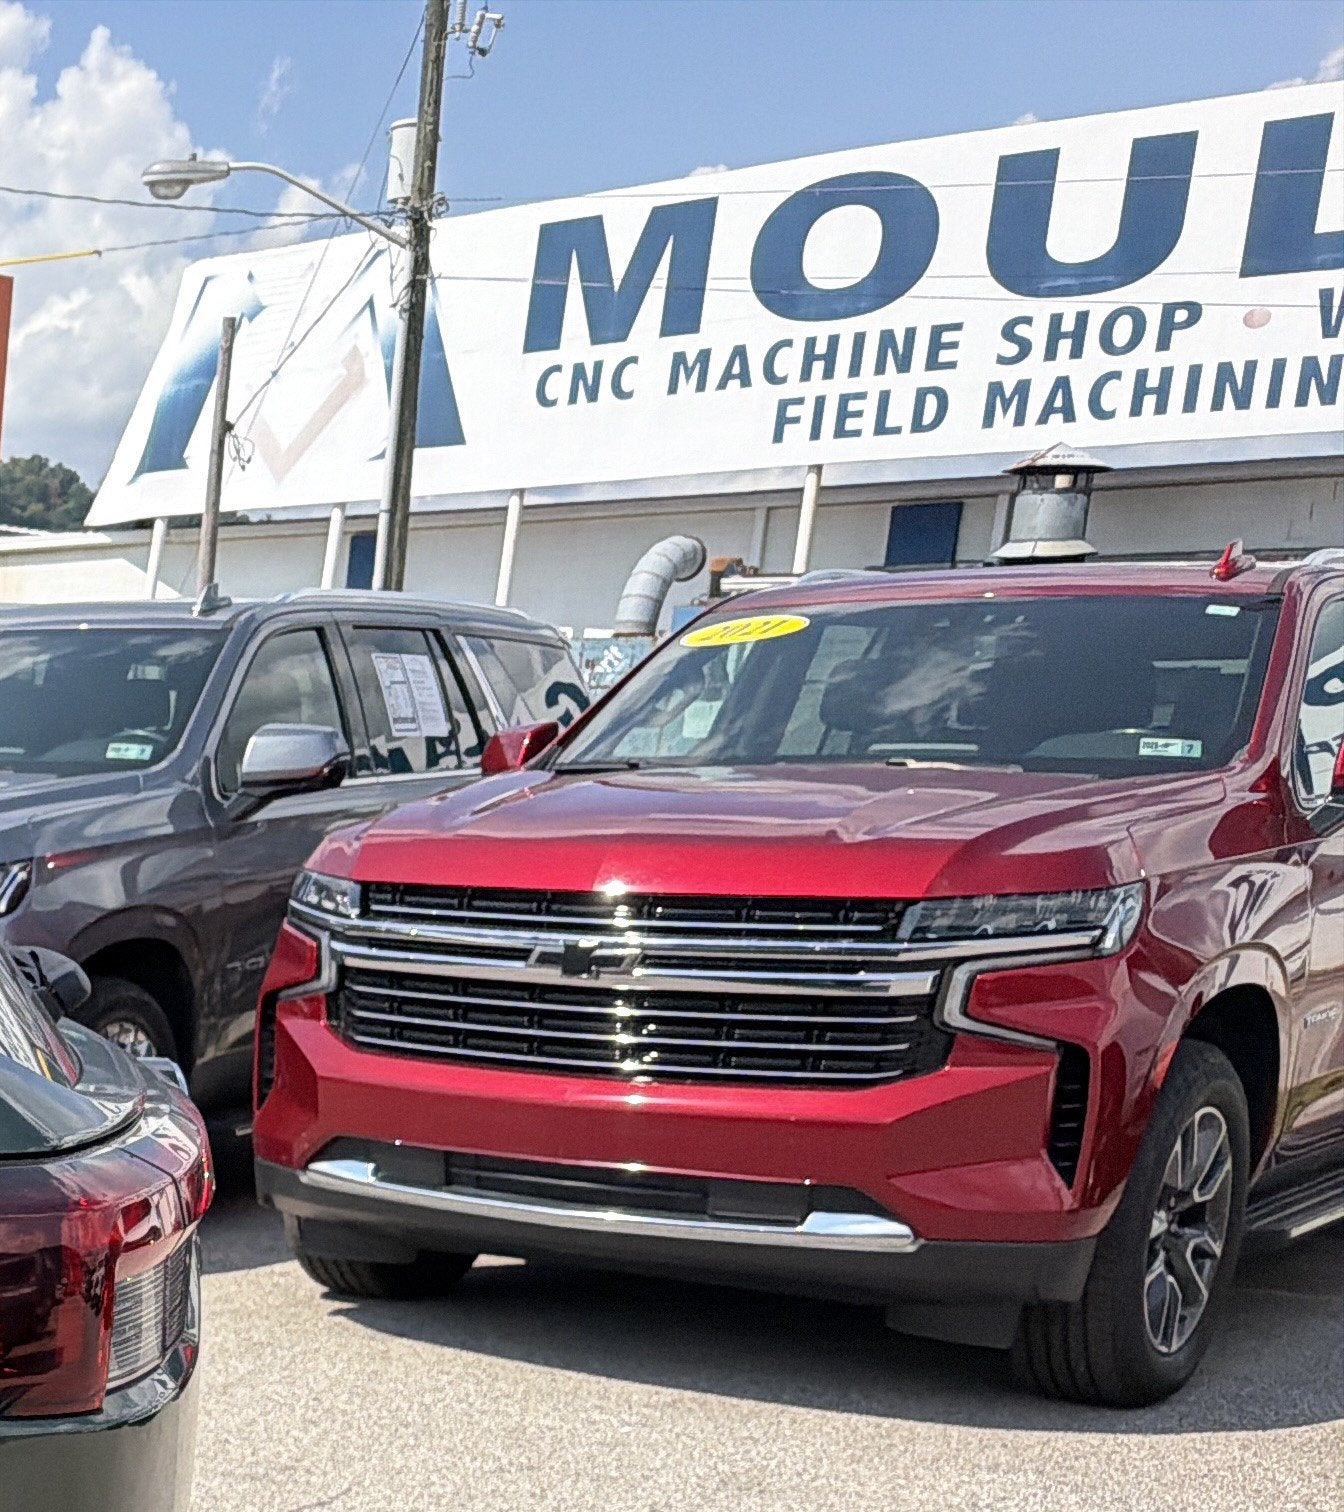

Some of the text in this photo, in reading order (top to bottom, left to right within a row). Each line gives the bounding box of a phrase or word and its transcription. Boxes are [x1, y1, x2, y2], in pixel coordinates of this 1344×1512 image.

[523, 112, 1344, 353] MOUL
[534, 300, 1203, 409] CNC MACHINE SHOP
[773, 354, 1344, 445] FIELD MACHININ
